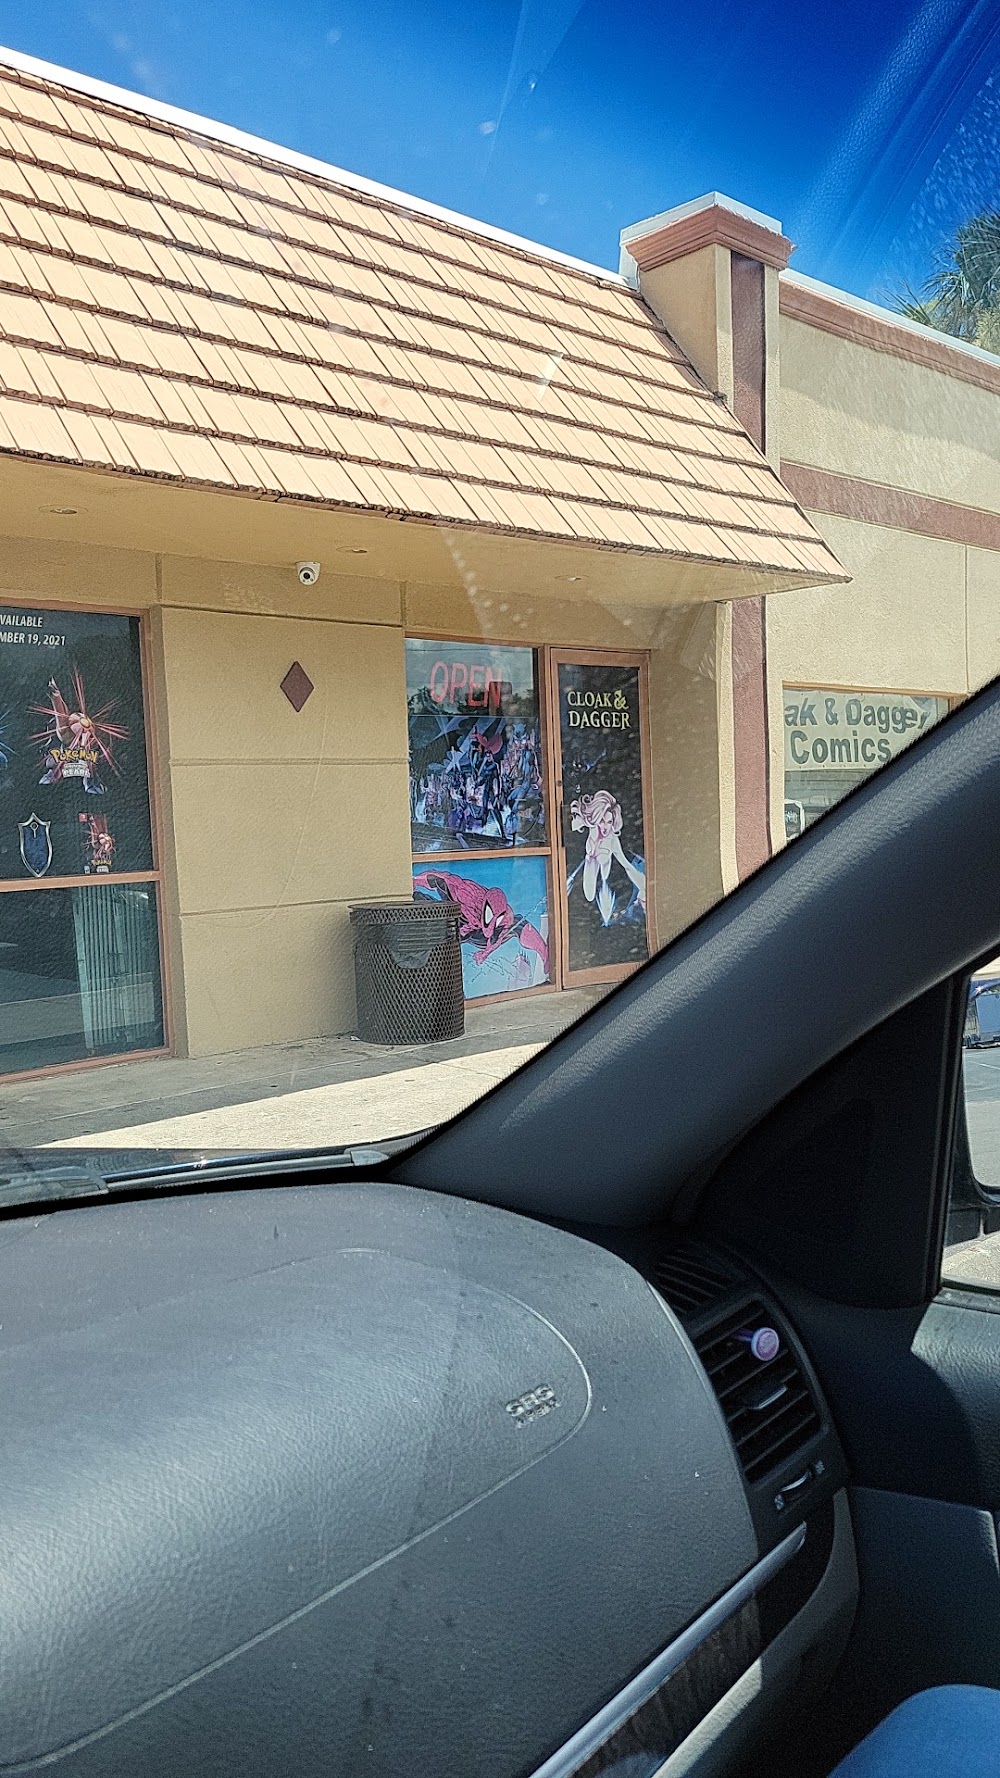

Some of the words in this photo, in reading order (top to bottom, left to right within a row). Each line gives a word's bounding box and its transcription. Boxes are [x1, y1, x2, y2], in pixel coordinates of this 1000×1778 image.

[0, 614, 43, 628] VAILABLE
[27, 633, 42, 647] 19,
[43, 634, 66, 646] 2021
[429, 660, 503, 708] OPEN
[567, 691, 612, 709] CLOAK
[568, 710, 632, 731] DAGGER
[824, 698, 839, 726] &
[845, 698, 931, 734] Dagger
[790, 729, 892, 765] Comics
